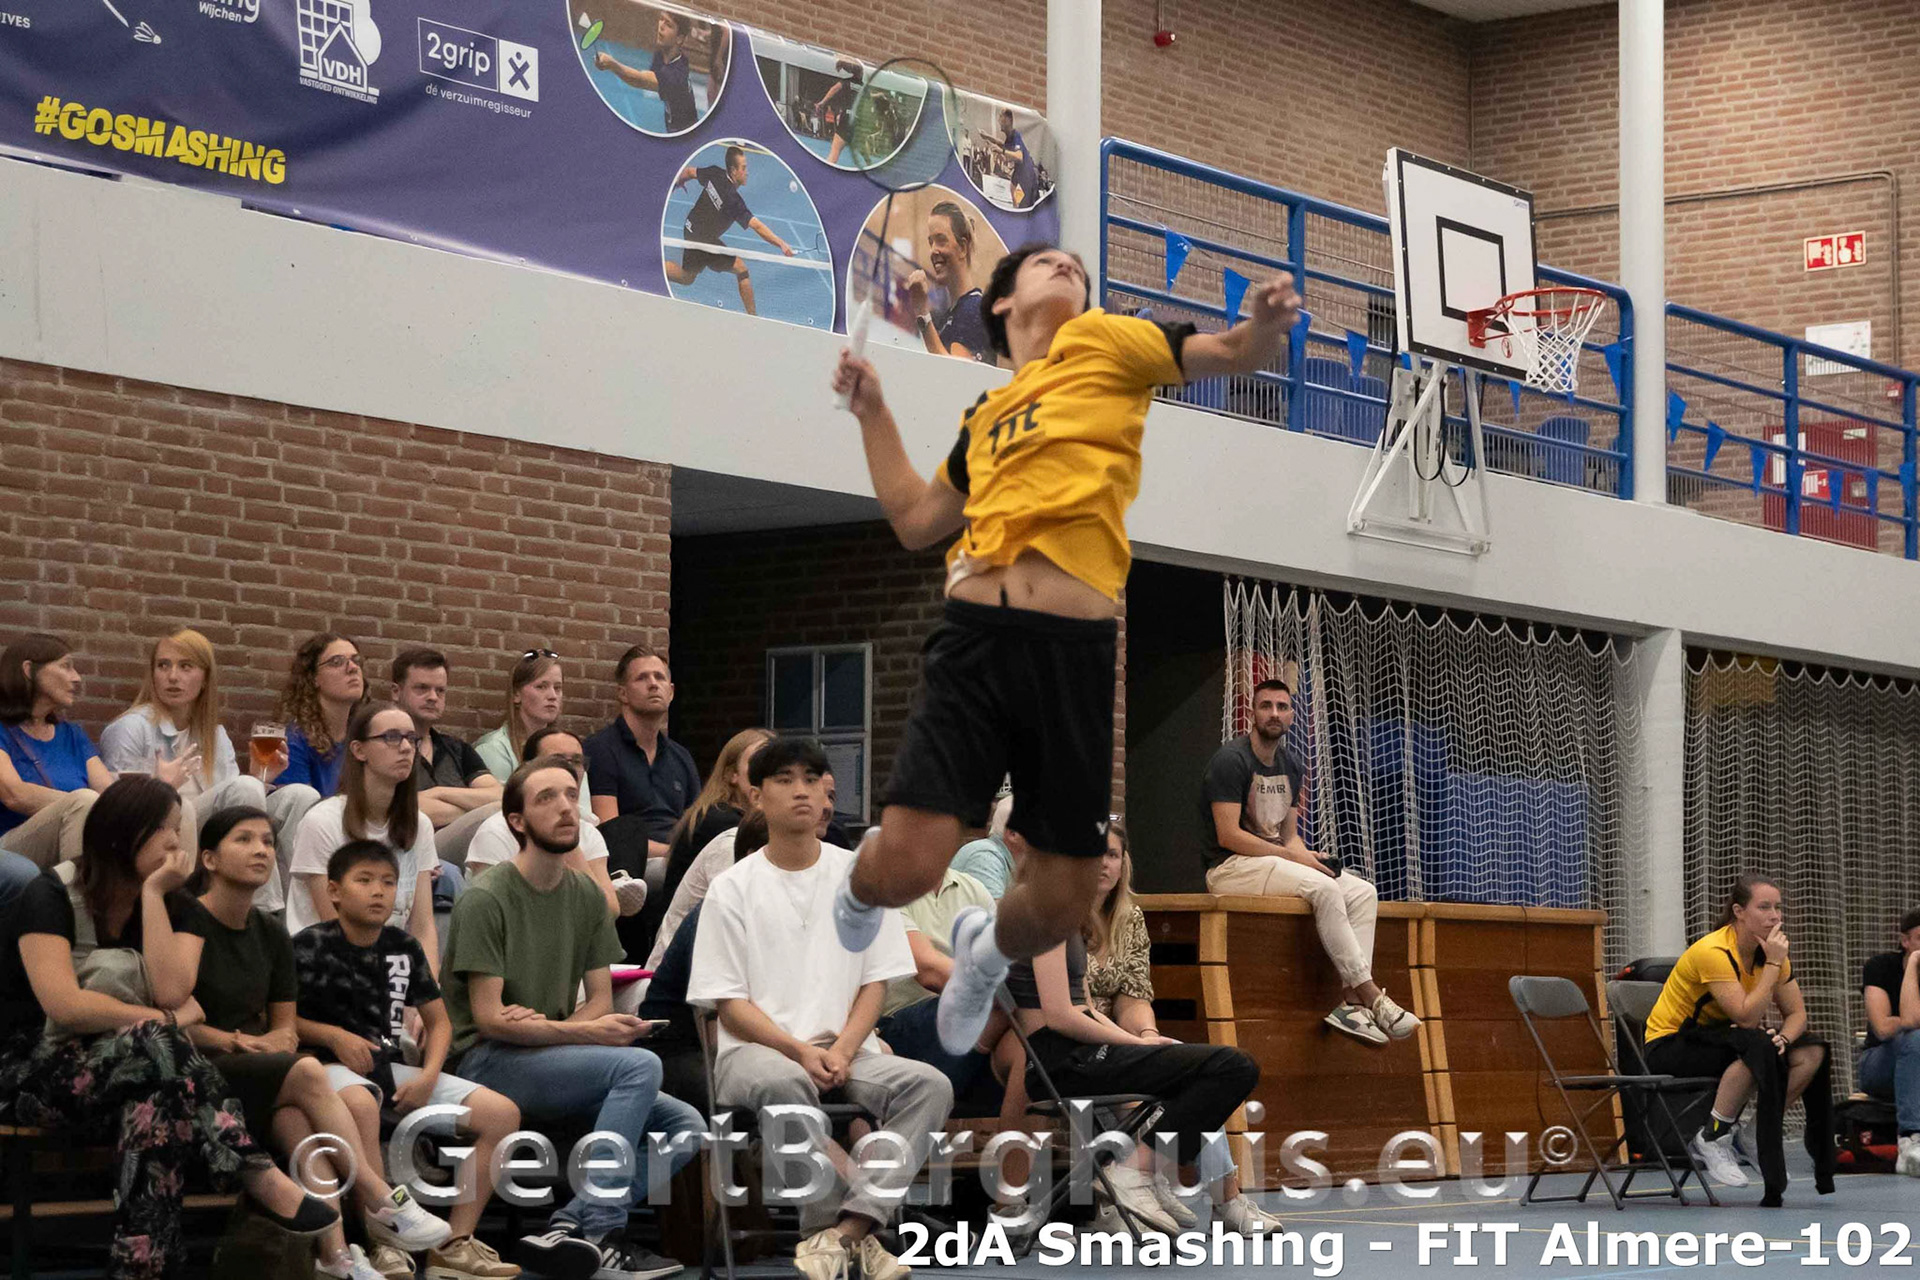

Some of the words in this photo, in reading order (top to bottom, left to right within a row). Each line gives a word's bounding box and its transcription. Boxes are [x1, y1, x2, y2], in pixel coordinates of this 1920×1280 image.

[0, 12, 31, 28] IVES
[199, 2, 242, 22] Wijchen
[427, 33, 491, 76] 2grip
[323, 58, 361, 85] VDH
[440, 89, 532, 118] verzuimregisseur
[34, 95, 286, 184] #GOSMASHING
